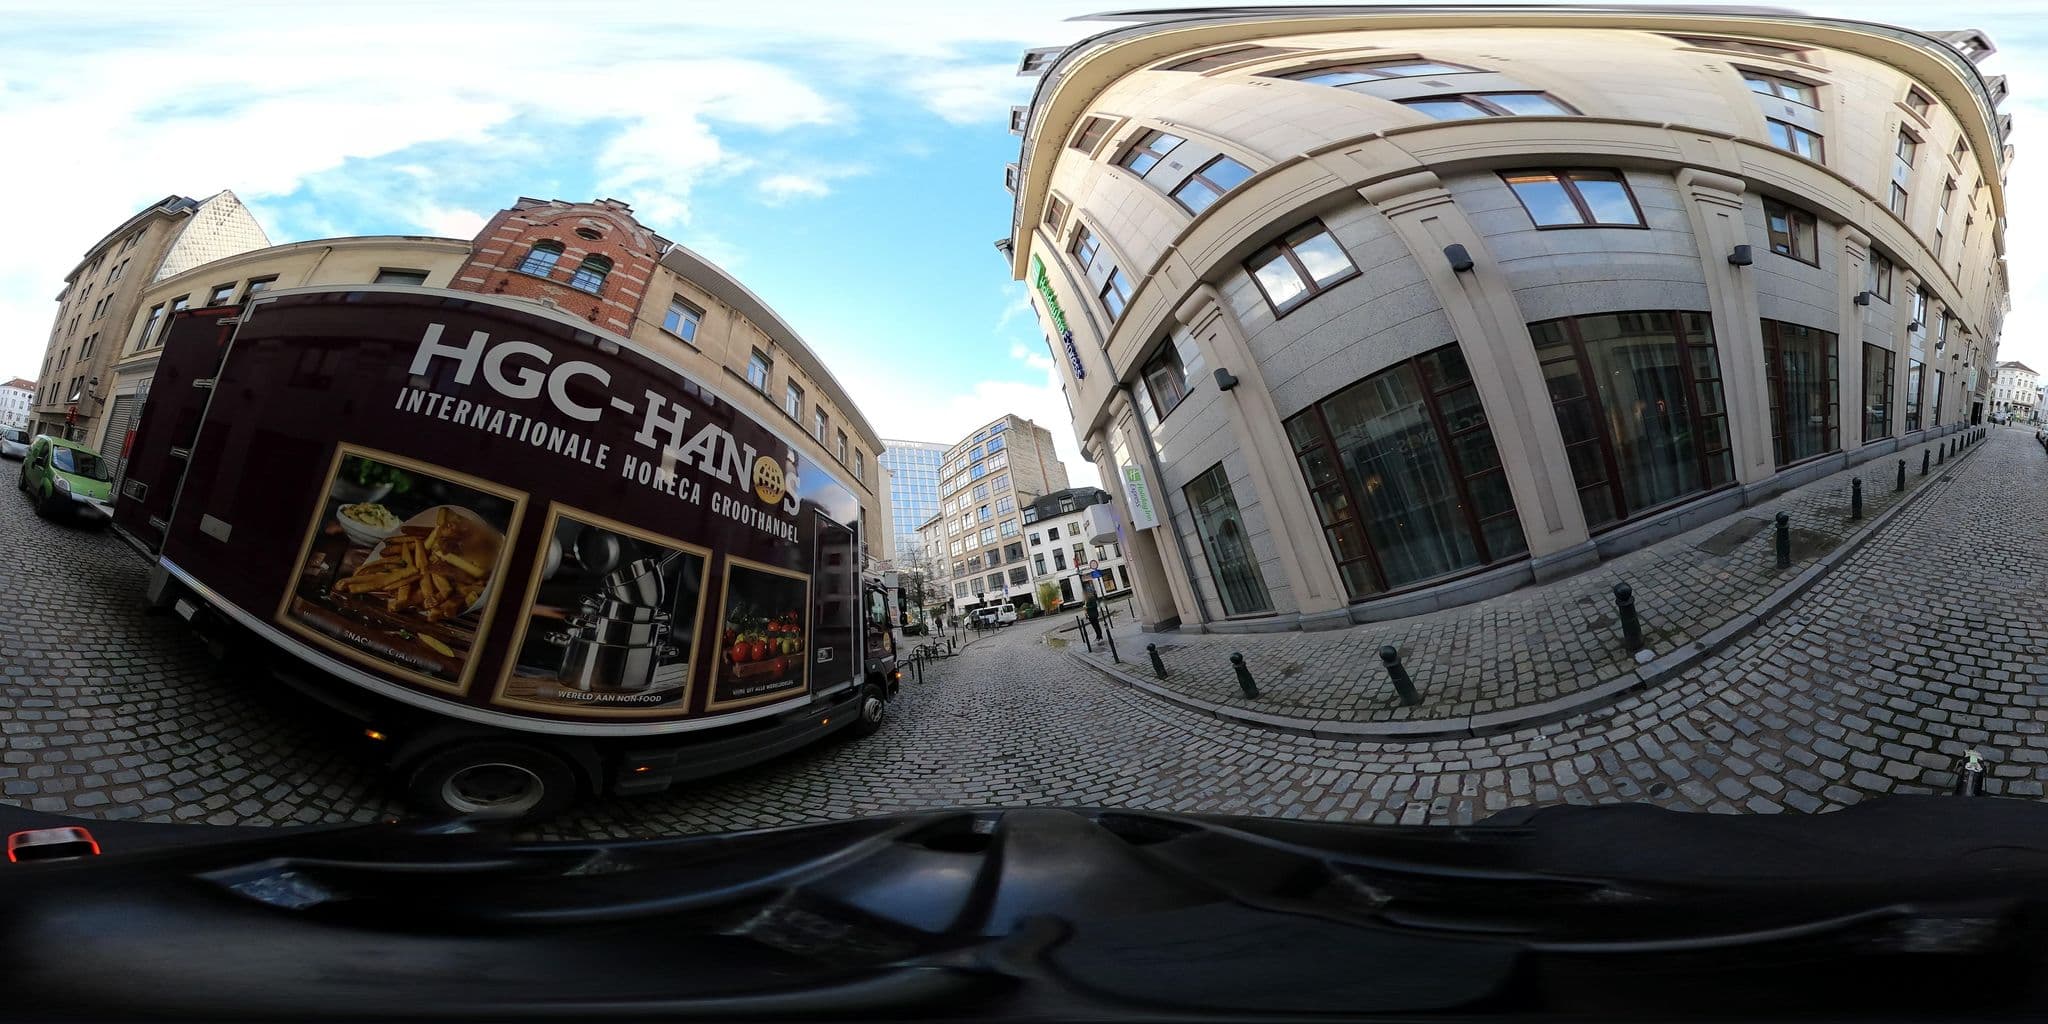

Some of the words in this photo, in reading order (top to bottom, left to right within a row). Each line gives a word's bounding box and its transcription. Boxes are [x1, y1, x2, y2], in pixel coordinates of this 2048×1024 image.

[395, 387, 611, 470] INTERNATIONALE
[621, 454, 702, 506] HORECA
[711, 492, 799, 544] GROOTHANDEL
[409, 323, 801, 516] HGC-HANOS
[558, 690, 593, 700] WERELD
[595, 694, 615, 702] AAN
